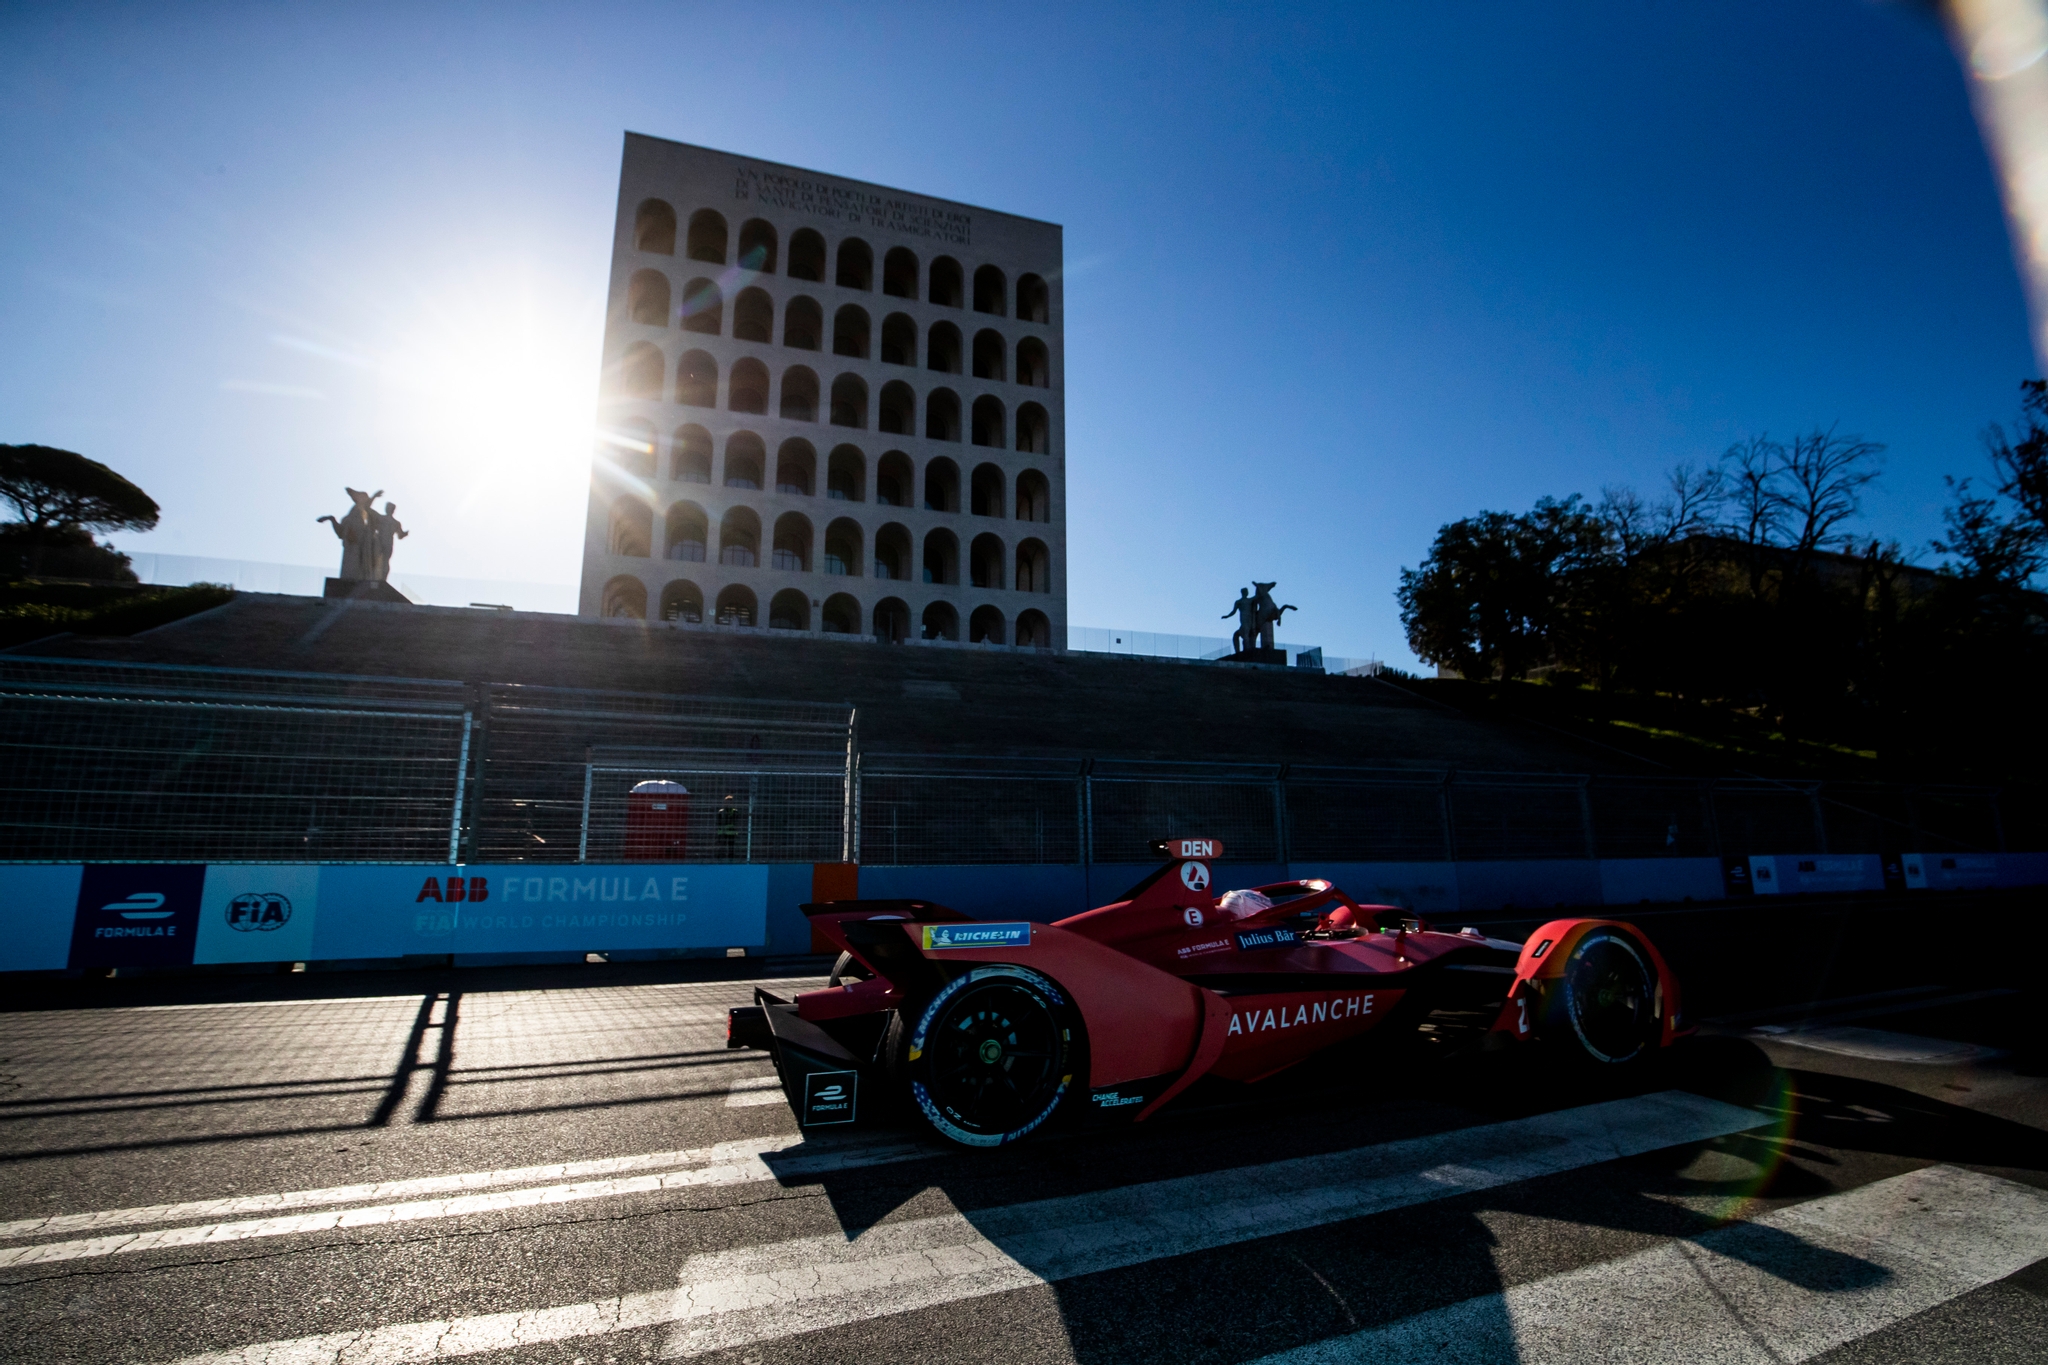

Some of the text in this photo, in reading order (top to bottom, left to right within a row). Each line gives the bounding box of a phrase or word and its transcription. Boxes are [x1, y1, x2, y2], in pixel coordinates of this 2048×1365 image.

[736, 178, 971, 235] DI SANTI DI PENSATORI DI SCIENZIATI
[764, 172, 812, 191] POPOLO
[816, 182, 829, 195] DI
[832, 186, 865, 202] POETI
[869, 194, 881, 205] DI
[885, 199, 928, 216] ARTISTI
[932, 208, 944, 219] DI
[947, 213, 971, 225] EROI
[735, 189, 749, 200] DI
[848, 212, 861, 223] DI
[871, 216, 971, 246] TRASMIGRATORI
[1181, 840, 1213, 857] DEN
[416, 876, 689, 903] ABB FORMULA E
[463, 915, 534, 930] WORLD
[541, 913, 687, 929] CHAMPIONSHIP
[1188, 910, 1199, 924] E
[94, 925, 177, 938] FORMULA E
[953, 930, 1021, 942] MICHELIN
[1238, 929, 1295, 949] Julius Bär
[1191, 939, 1224, 952] FORMULA
[1223, 938, 1230, 947] E
[918, 975, 968, 1035] MICHELIN
[1227, 994, 1375, 1037] AVALANCHE
[1092, 1091, 1120, 1102] CHANGE
[1100, 1095, 1144, 1108] ACCELERATED
[811, 1103, 843, 1112] FORMULA
[1005, 1095, 1060, 1142] MICHELIN
